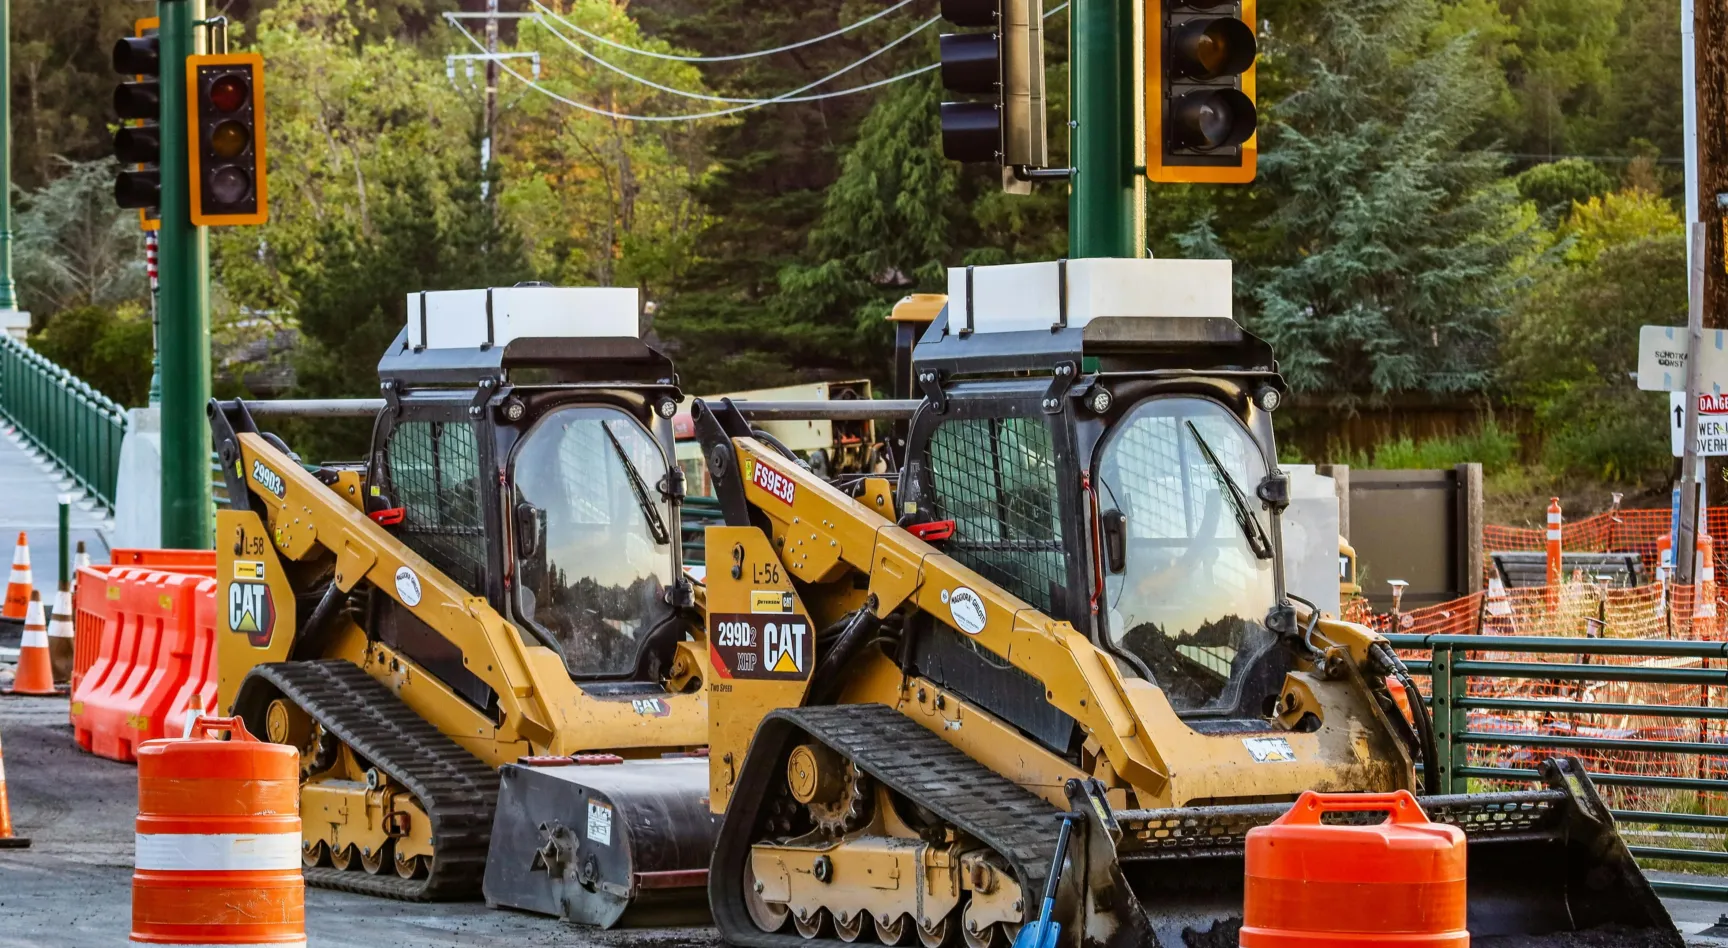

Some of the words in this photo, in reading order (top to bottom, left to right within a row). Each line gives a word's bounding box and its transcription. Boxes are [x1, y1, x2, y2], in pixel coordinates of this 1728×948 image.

[253, 460, 281, 495] 299D3
[753, 461, 795, 503] FS9E38
[245, 536, 264, 555] L-58
[753, 562, 779, 584] L-56
[229, 583, 265, 632] CAT
[783, 597, 792, 608] CAT
[718, 621, 756, 648] 299D2
[763, 623, 806, 673] CAT
[737, 652, 757, 672] XHP
[632, 698, 661, 714] CAT
